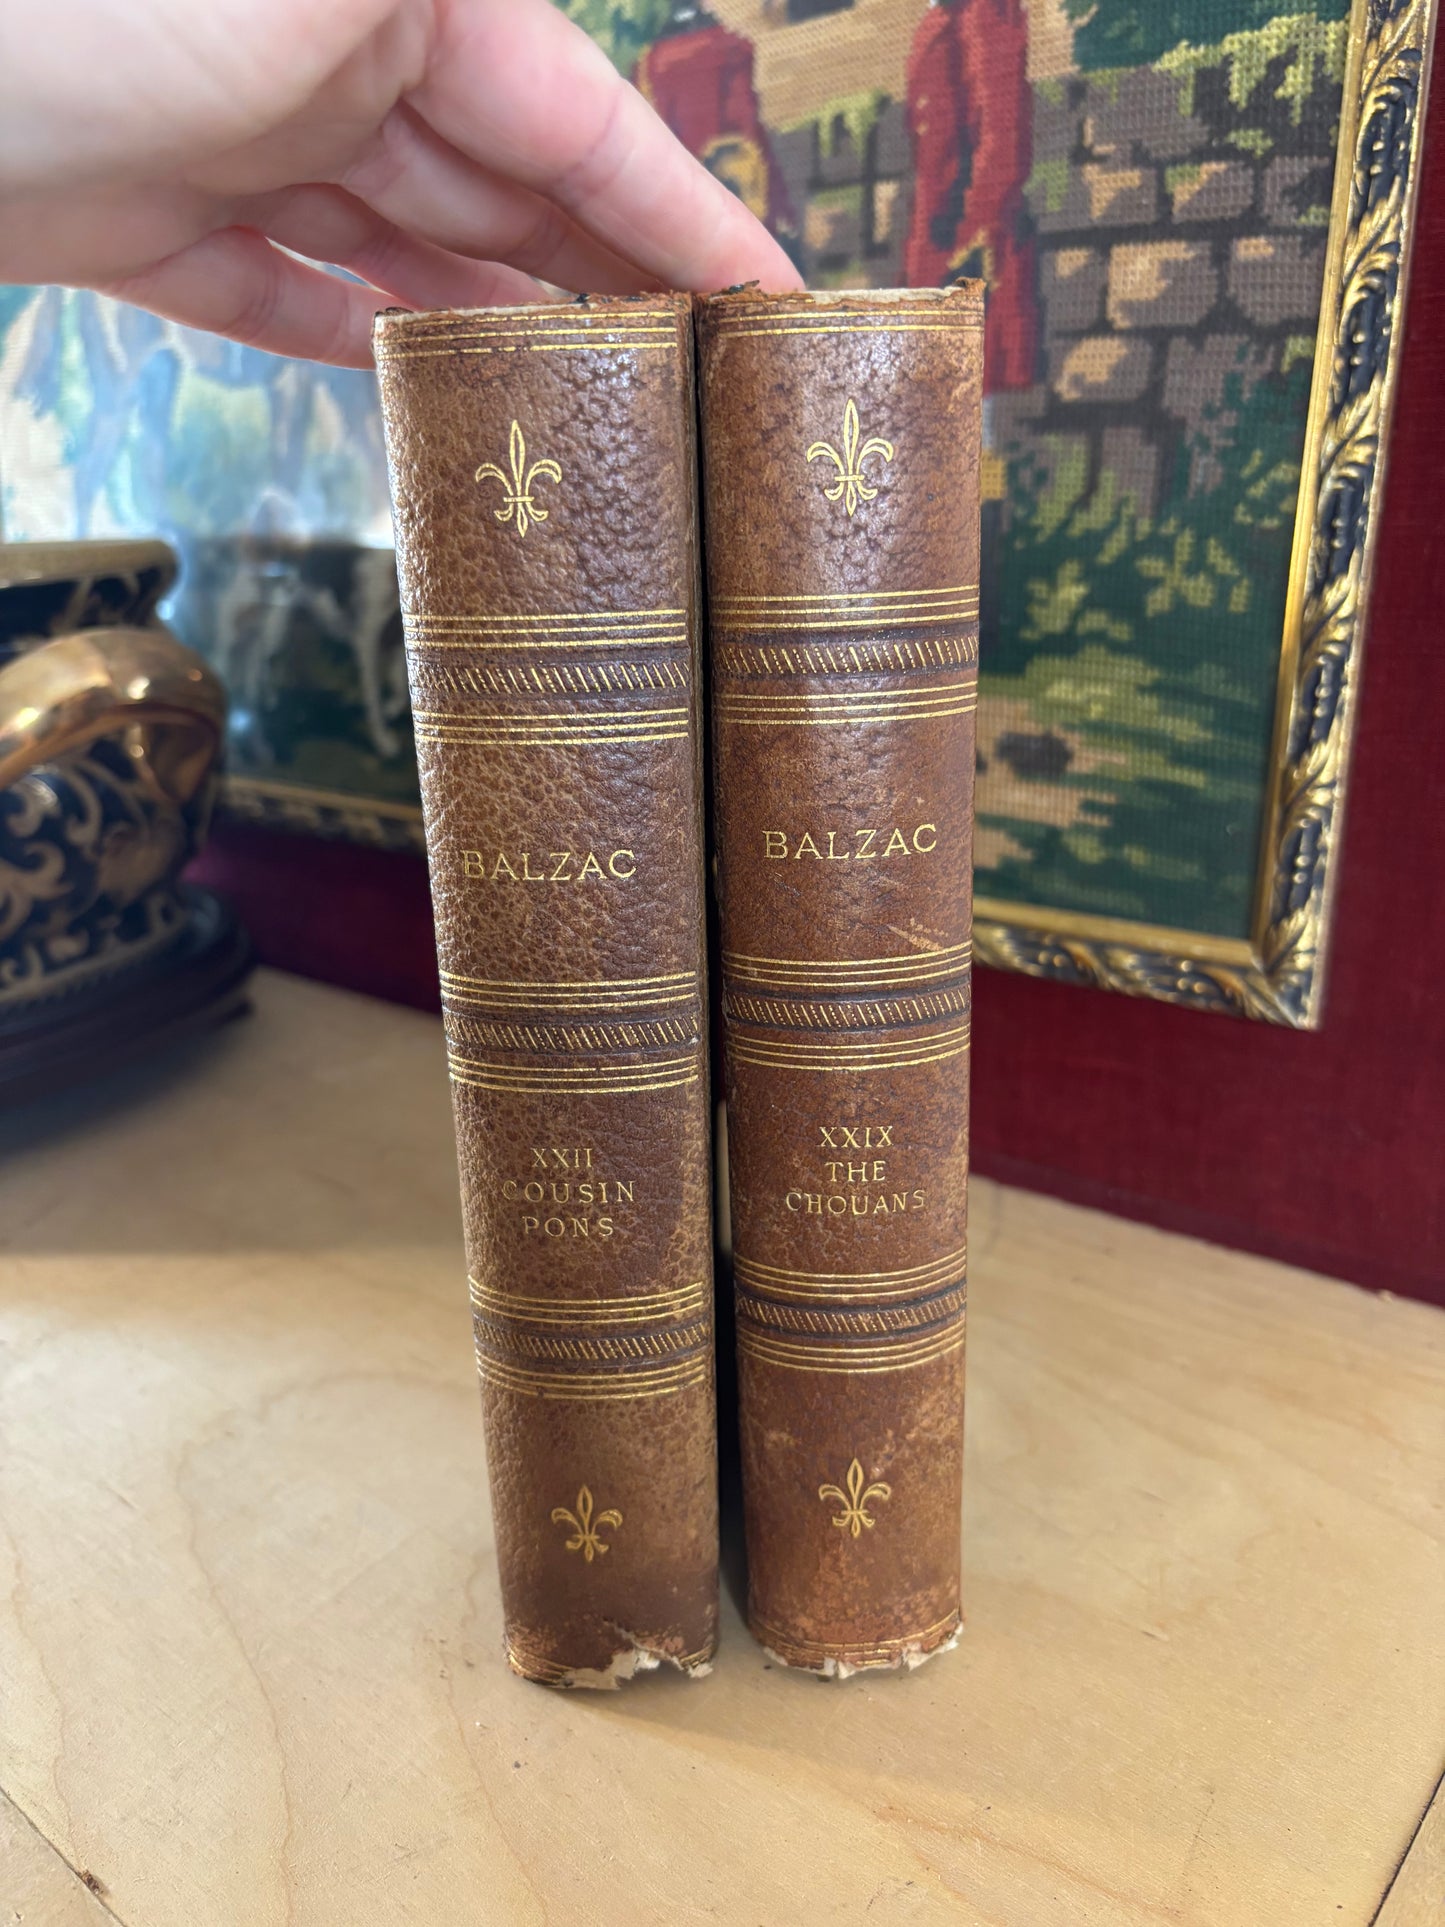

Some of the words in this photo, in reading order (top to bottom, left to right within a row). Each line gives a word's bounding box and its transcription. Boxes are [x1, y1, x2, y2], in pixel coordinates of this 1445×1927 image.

[762, 823, 938, 860] BALZAC
[463, 849, 638, 882] BALZAC
[818, 1125, 894, 1149] XXIX
[530, 1147, 594, 1170] XXII
[824, 1160, 887, 1183] THE
[501, 1180, 636, 1204] COUSIN
[785, 1189, 927, 1216] CHOUANS
[522, 1215, 615, 1238] PONS
